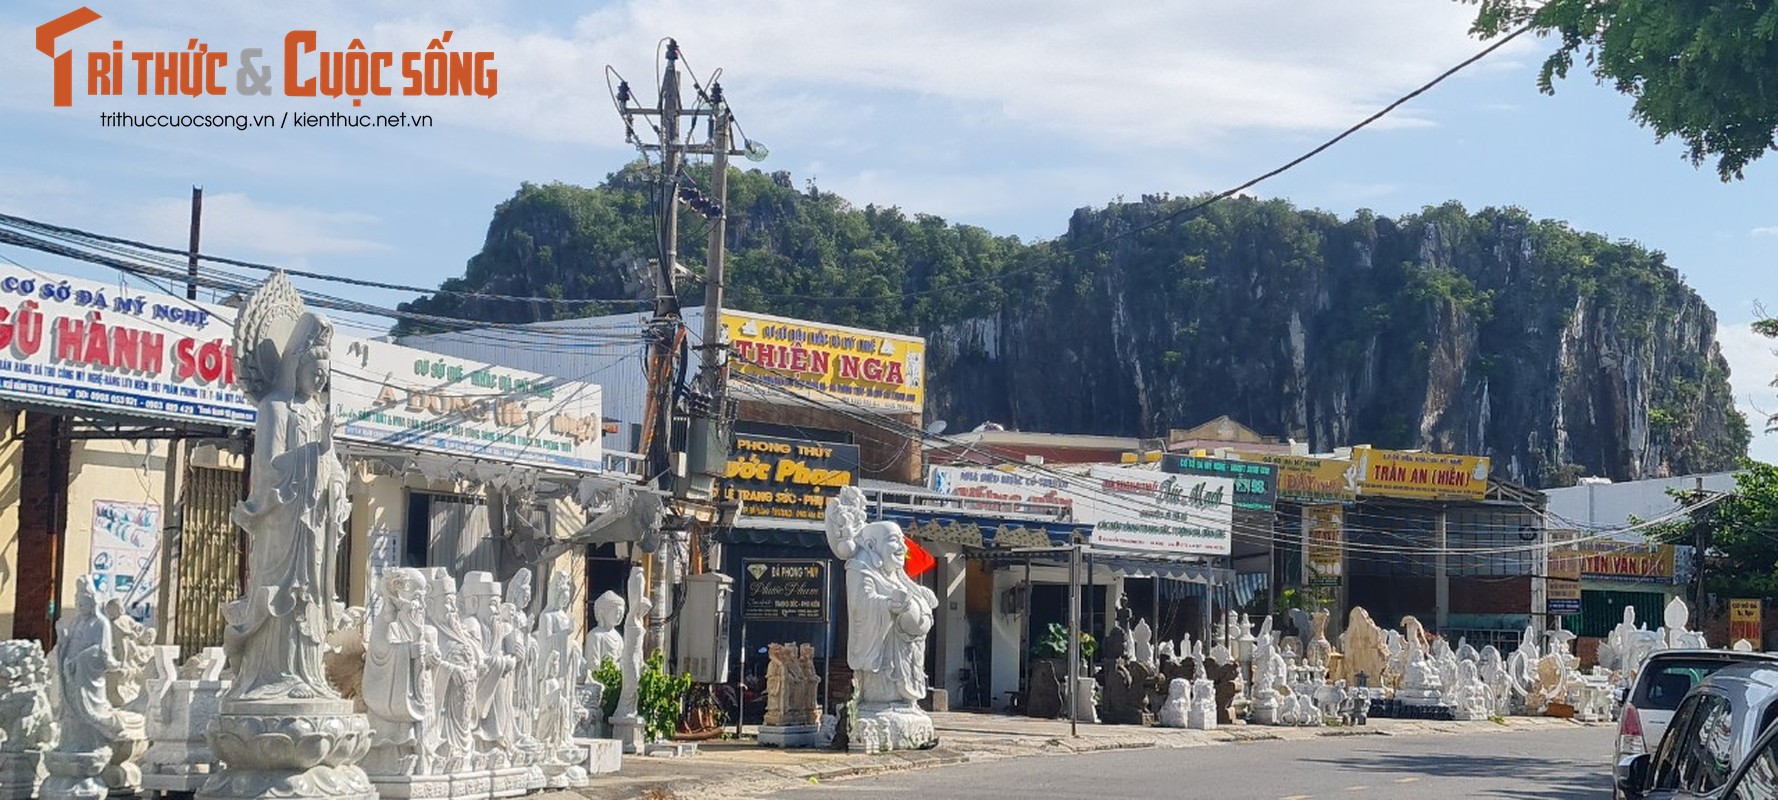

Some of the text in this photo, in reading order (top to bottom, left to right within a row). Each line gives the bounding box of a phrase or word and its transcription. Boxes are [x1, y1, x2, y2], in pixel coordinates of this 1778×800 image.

[52, 310, 165, 375] HÀNH
[840, 353, 904, 385] NGA
[737, 439, 833, 458] PHONG THỦY
[1410, 467, 1428, 484] AN
[739, 489, 772, 502] TRANG
[775, 487, 797, 504] SỨC
